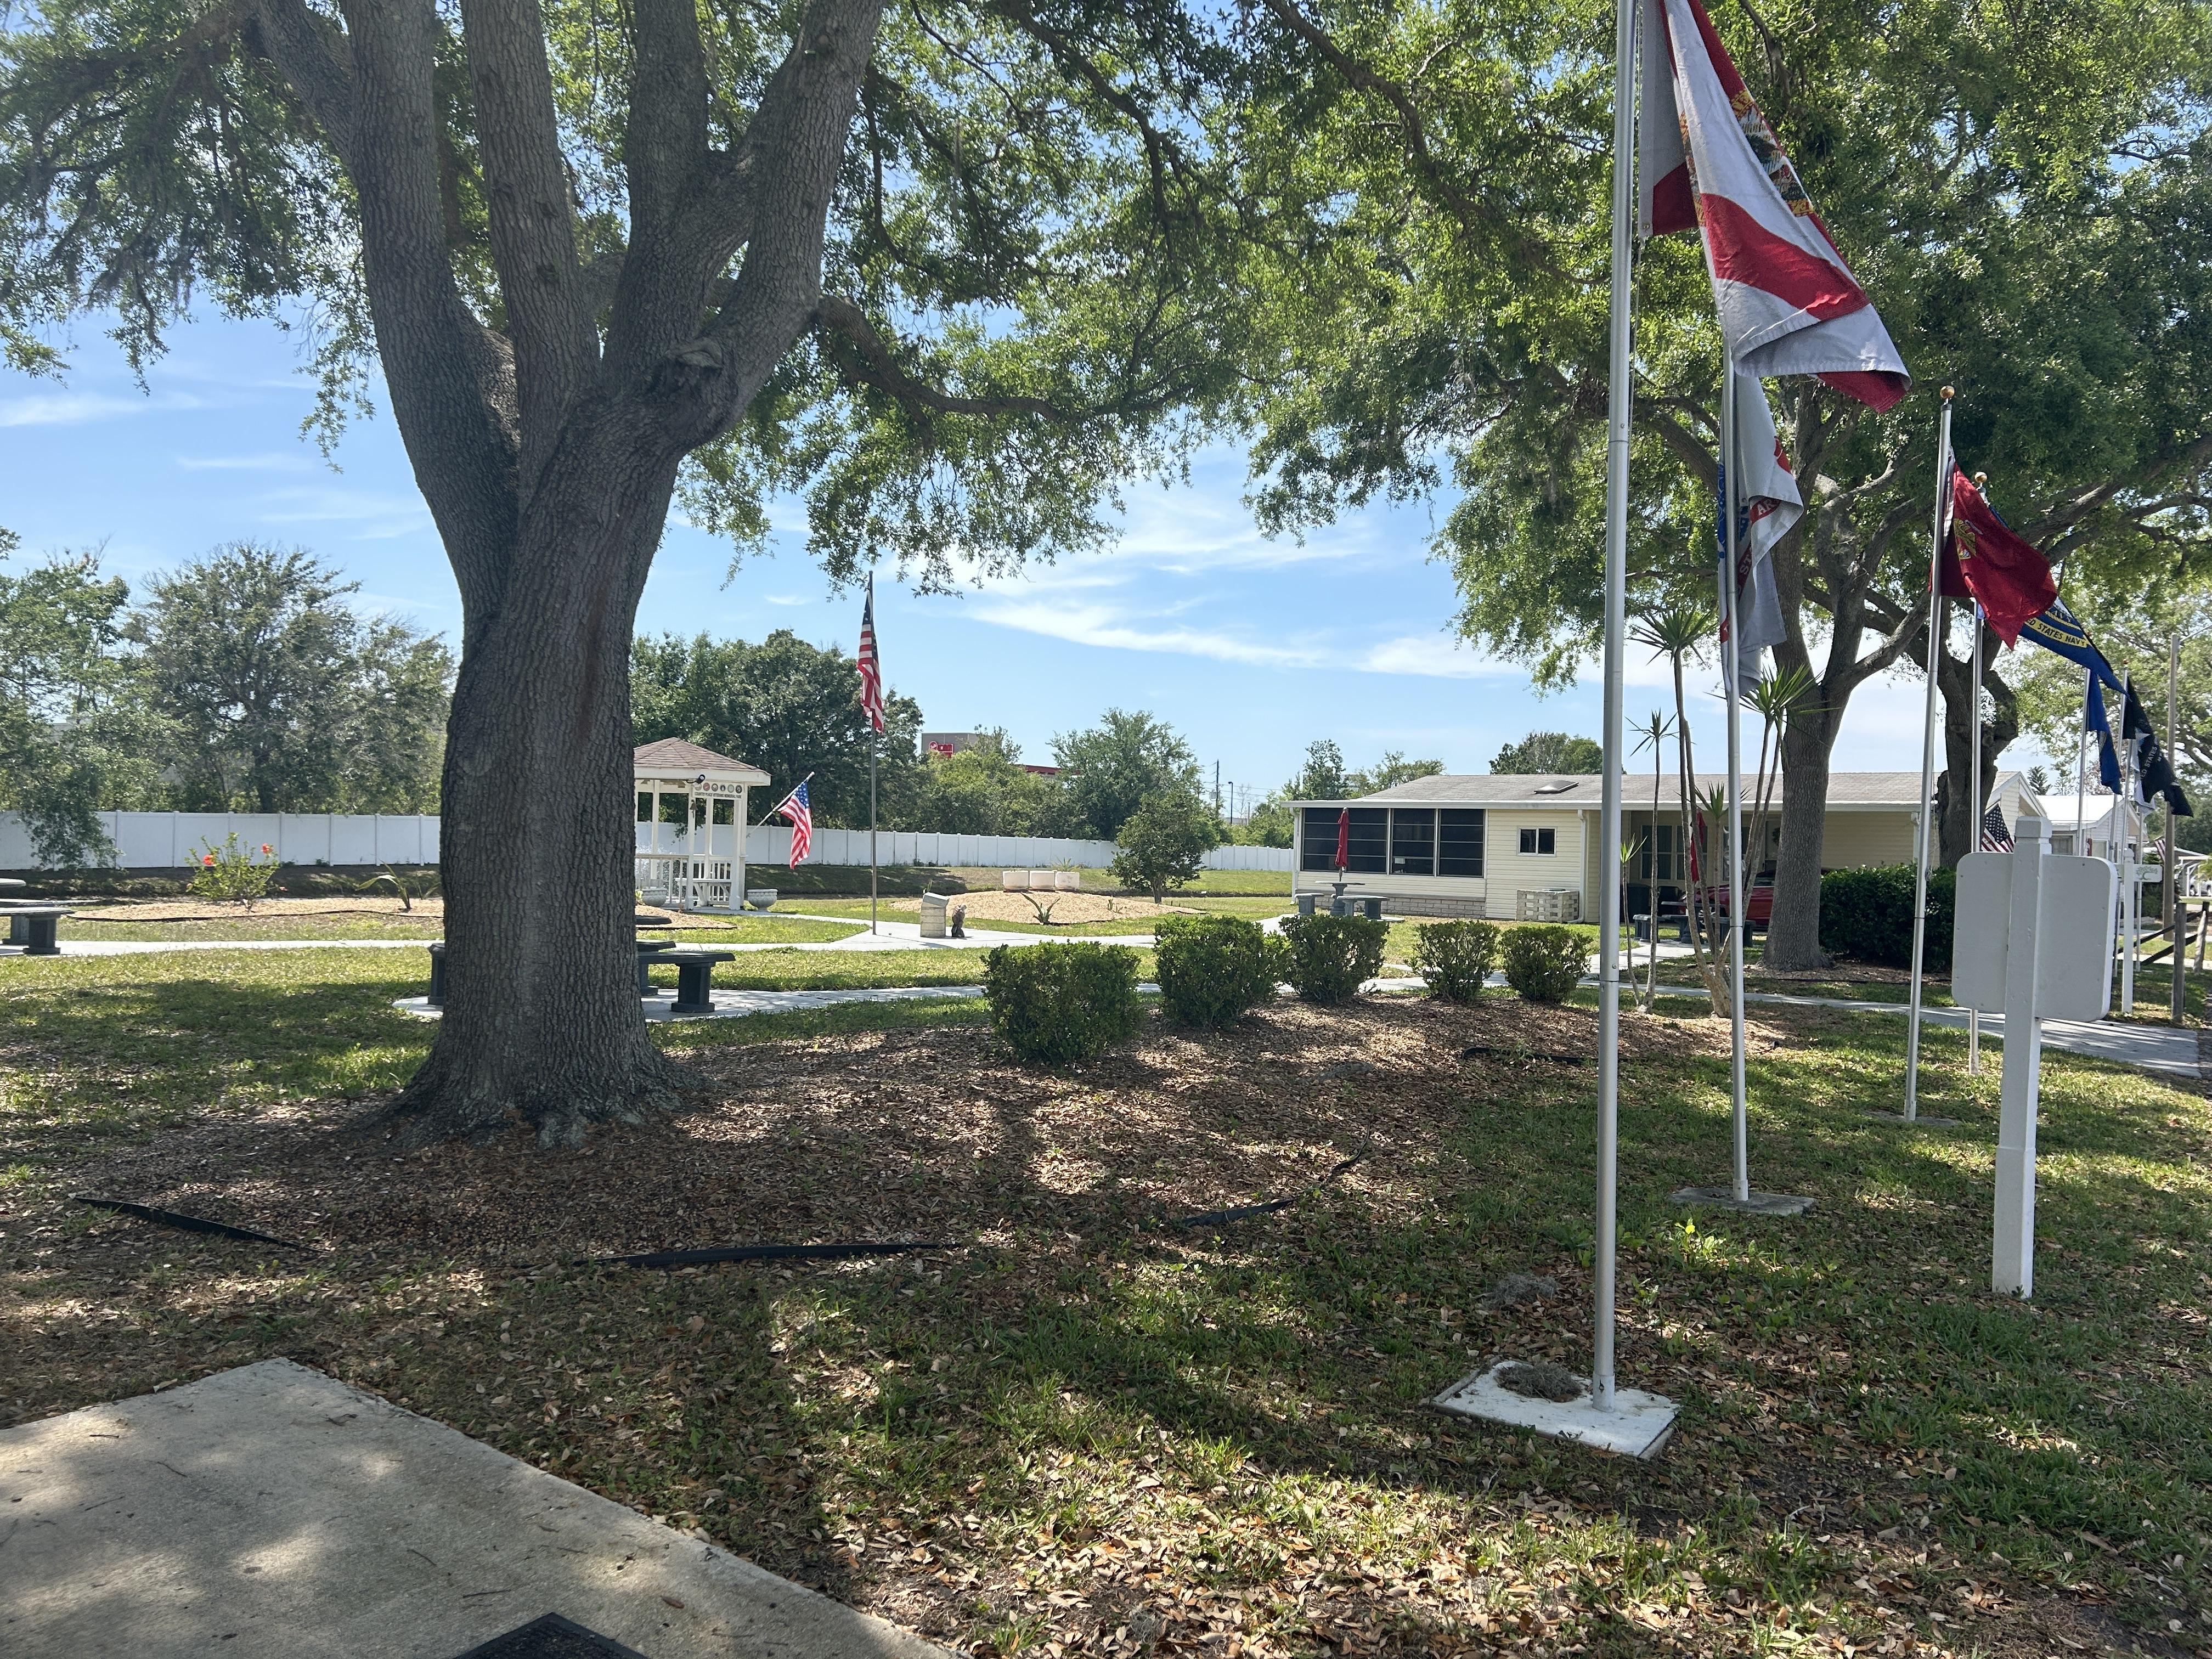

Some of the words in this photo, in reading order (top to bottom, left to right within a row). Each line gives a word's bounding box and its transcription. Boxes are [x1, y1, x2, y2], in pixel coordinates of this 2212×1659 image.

[2038, 623, 2063, 640] STATES
[2065, 635, 2085, 646] NAVY
[2145, 746, 2158, 768] STATES
